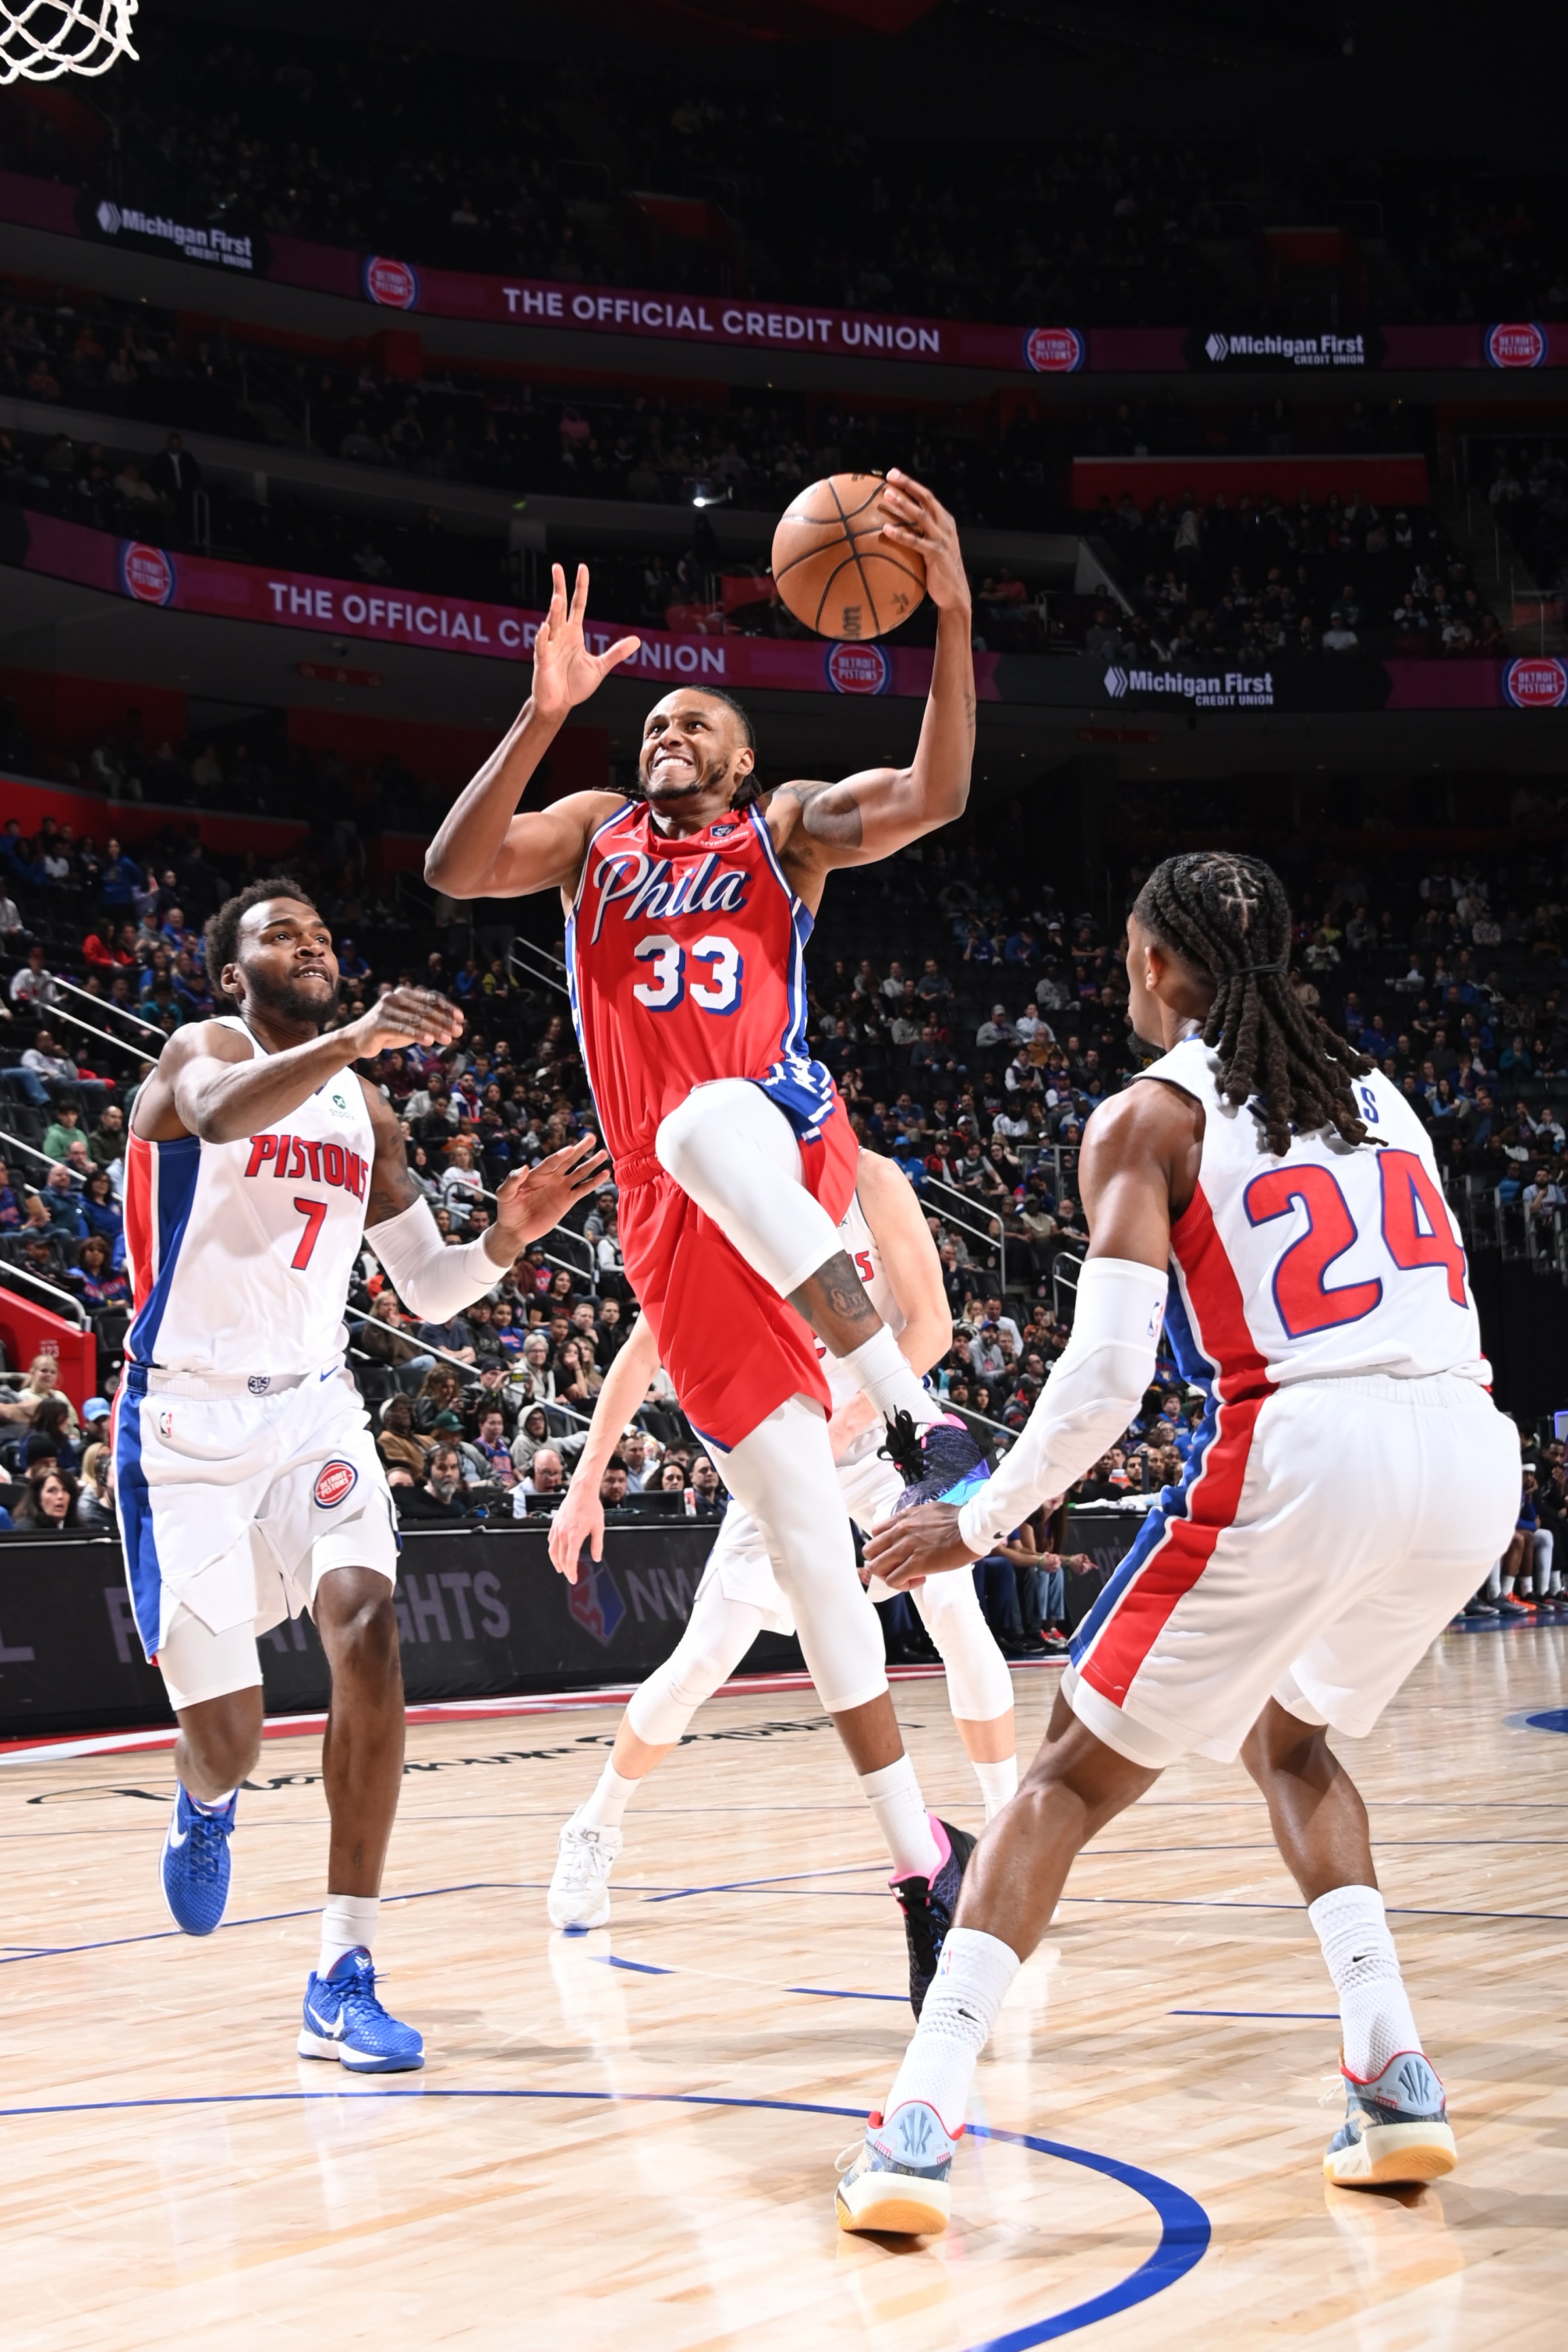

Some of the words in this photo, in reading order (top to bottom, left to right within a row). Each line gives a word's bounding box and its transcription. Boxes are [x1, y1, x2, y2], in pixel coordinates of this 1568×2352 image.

[122, 208, 208, 247] Michigan
[210, 228, 252, 257] First
[184, 244, 220, 262] CREDIT
[221, 253, 253, 269] UNION
[503, 288, 563, 317] THE
[572, 295, 713, 332] OFFICIAL
[722, 309, 832, 342] CREDIT
[841, 322, 940, 353] UNION
[1230, 335, 1317, 357] Michigan
[1320, 335, 1364, 354] First
[1294, 354, 1330, 365] CREDIT
[1332, 354, 1364, 365] UNION
[269, 583, 333, 619] THE
[342, 595, 489, 644] OFFICIAL
[498, 620, 610, 652] CRIT
[1128, 671, 1220, 698] Michigan
[1224, 672, 1273, 693] First
[1195, 695, 1235, 706] CREDIT
[1239, 694, 1273, 705] UNION
[700, 831, 749, 847] crypto.com
[590, 850, 752, 946] Phila
[633, 934, 744, 1017] 33
[244, 1134, 368, 1204] PISTONS
[290, 1196, 328, 1271] 7
[1242, 1148, 1470, 1340] 24
[319, 1470, 347, 1490] DETROIT
[320, 1478, 350, 1497] PISTONS
